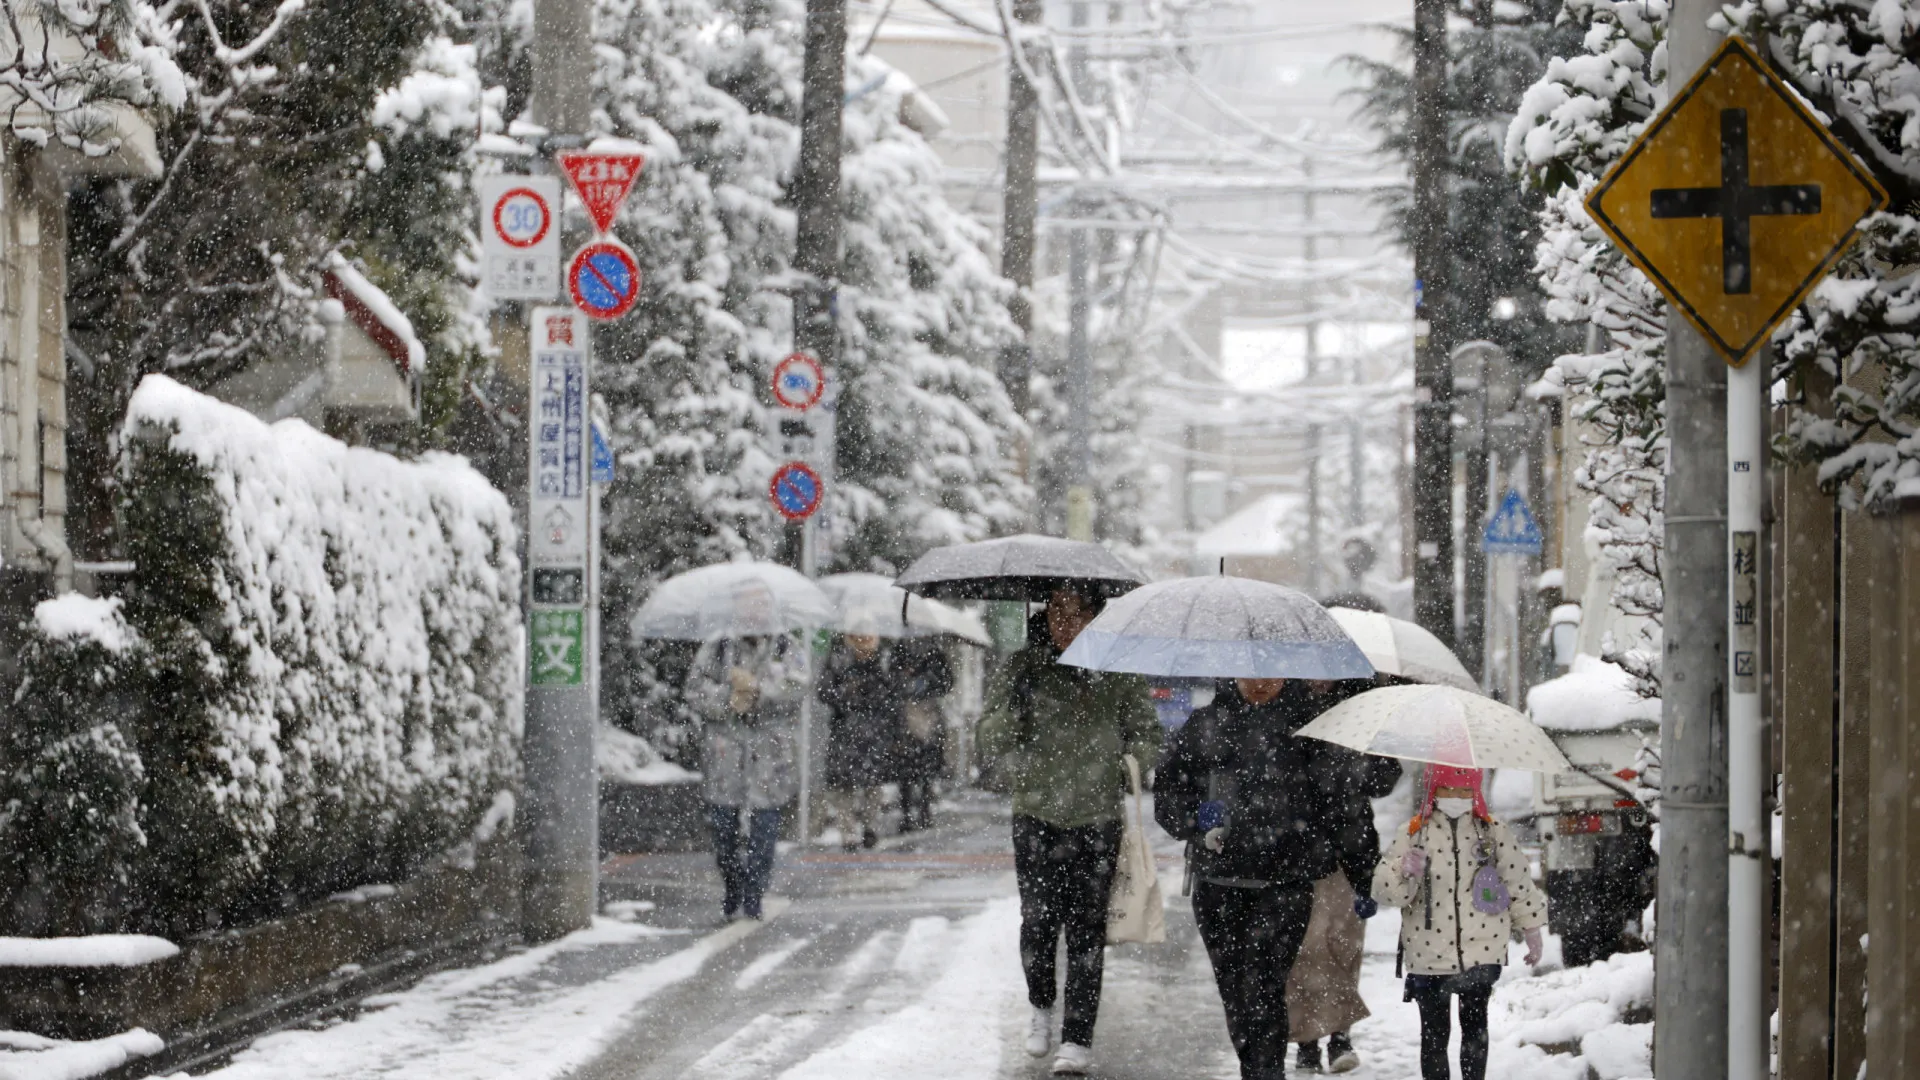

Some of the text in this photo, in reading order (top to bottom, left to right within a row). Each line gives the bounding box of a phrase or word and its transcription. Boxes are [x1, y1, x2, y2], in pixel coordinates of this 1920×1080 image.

[507, 203, 539, 232] 30
[1734, 548, 1755, 676] 杉並区
